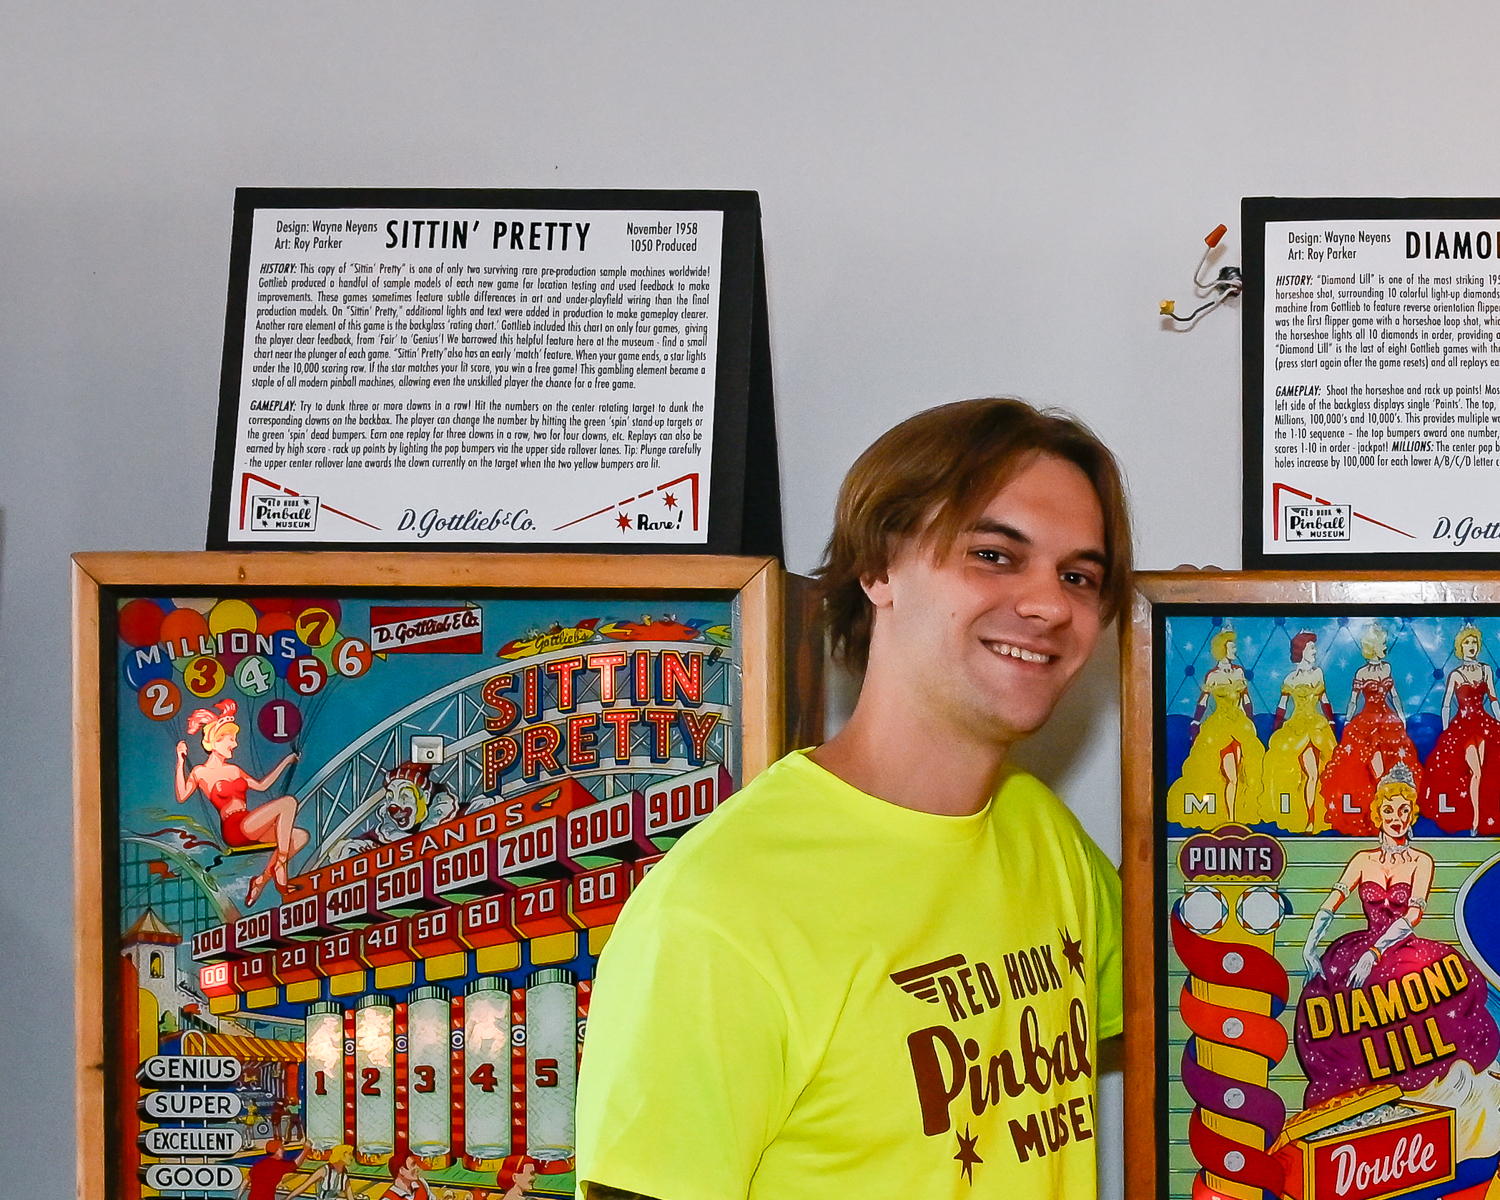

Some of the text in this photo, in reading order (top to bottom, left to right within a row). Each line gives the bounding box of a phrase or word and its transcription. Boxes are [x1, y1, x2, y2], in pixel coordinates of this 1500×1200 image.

[276, 220, 378, 235] Design: Wayne Neyens
[385, 220, 591, 251] SITTIN' PRETTY
[626, 222, 698, 235] November 1958
[1288, 231, 1391, 246] Design: Wayne Neyens
[274, 237, 343, 252] Art: Roy Parker
[630, 239, 697, 252] 1050 Produced
[1288, 247, 1357, 262] Art: Roy Parker
[259, 262, 298, 274] HISTORY:
[300, 262, 315, 273] This
[317, 265, 336, 276] copy
[338, 263, 346, 274] of
[409, 263, 416, 274] is
[418, 266, 433, 274] one
[435, 264, 444, 274] of
[446, 264, 464, 277] only
[466, 264, 481, 274] two
[483, 264, 518, 278] surviving
[521, 267, 538, 275] rare
[541, 264, 596, 278] pre-production
[599, 265, 627, 279] sample
[630, 265, 666, 277] machines
[668, 266, 710, 277] worldwide!
[1275, 274, 1314, 286] HISTORY:
[1378, 274, 1385, 284] is
[1388, 276, 1403, 284] one
[1406, 274, 1414, 285] of
[1417, 274, 1430, 285] the
[1433, 275, 1452, 285] most
[1455, 274, 1484, 287] striking
[256, 505, 311, 520] Pinball
[637, 510, 683, 531] Rare!
[1290, 516, 1345, 530] Pinball
[299, 612, 330, 646] 7
[534, 628, 588, 653] Gottlieb's
[135, 632, 296, 669] MILLIONS
[338, 640, 364, 677] 6
[190, 658, 218, 693] 3
[239, 657, 272, 694] 4
[298, 659, 322, 693] 5
[146, 684, 174, 716] 2
[482, 649, 703, 733] SITTIN
[273, 706, 288, 737] 1
[483, 708, 721, 793] PRETTY
[650, 777, 714, 828] 900
[570, 802, 632, 850] 800
[310, 803, 524, 889] THOUSANDS
[500, 826, 553, 869] 700
[1189, 847, 1271, 871] POINTS
[437, 848, 484, 886] 600
[378, 866, 422, 903] 500
[579, 871, 615, 904] 80
[281, 899, 318, 931] 300
[327, 884, 366, 917] 400
[468, 900, 499, 927] 60
[520, 887, 554, 916] 70
[237, 914, 270, 943] 200
[367, 924, 397, 948] 40
[418, 912, 446, 939] 50
[192, 928, 226, 955] 100
[324, 936, 350, 959] 30
[242, 957, 263, 977] 10
[281, 947, 306, 968] 20
[204, 966, 226, 985] 00
[937, 944, 1062, 1022] RED HOOK
[1305, 953, 1469, 1039] DIAMOND
[1361, 1017, 1457, 1079] LILL
[149, 1059, 236, 1079] GENIUS
[414, 1065, 436, 1093] 3
[469, 1063, 498, 1093] 4
[535, 1058, 559, 1088] 5
[907, 998, 1092, 1136] Pinbal
[314, 1070, 327, 1096] 1
[361, 1067, 381, 1097] 2
[155, 1095, 232, 1114] SUPER
[153, 1132, 234, 1150] EXCELLENT
[1007, 1094, 1095, 1163] MUSE
[155, 1168, 233, 1187] GOOD
[1330, 1133, 1437, 1197] Double
